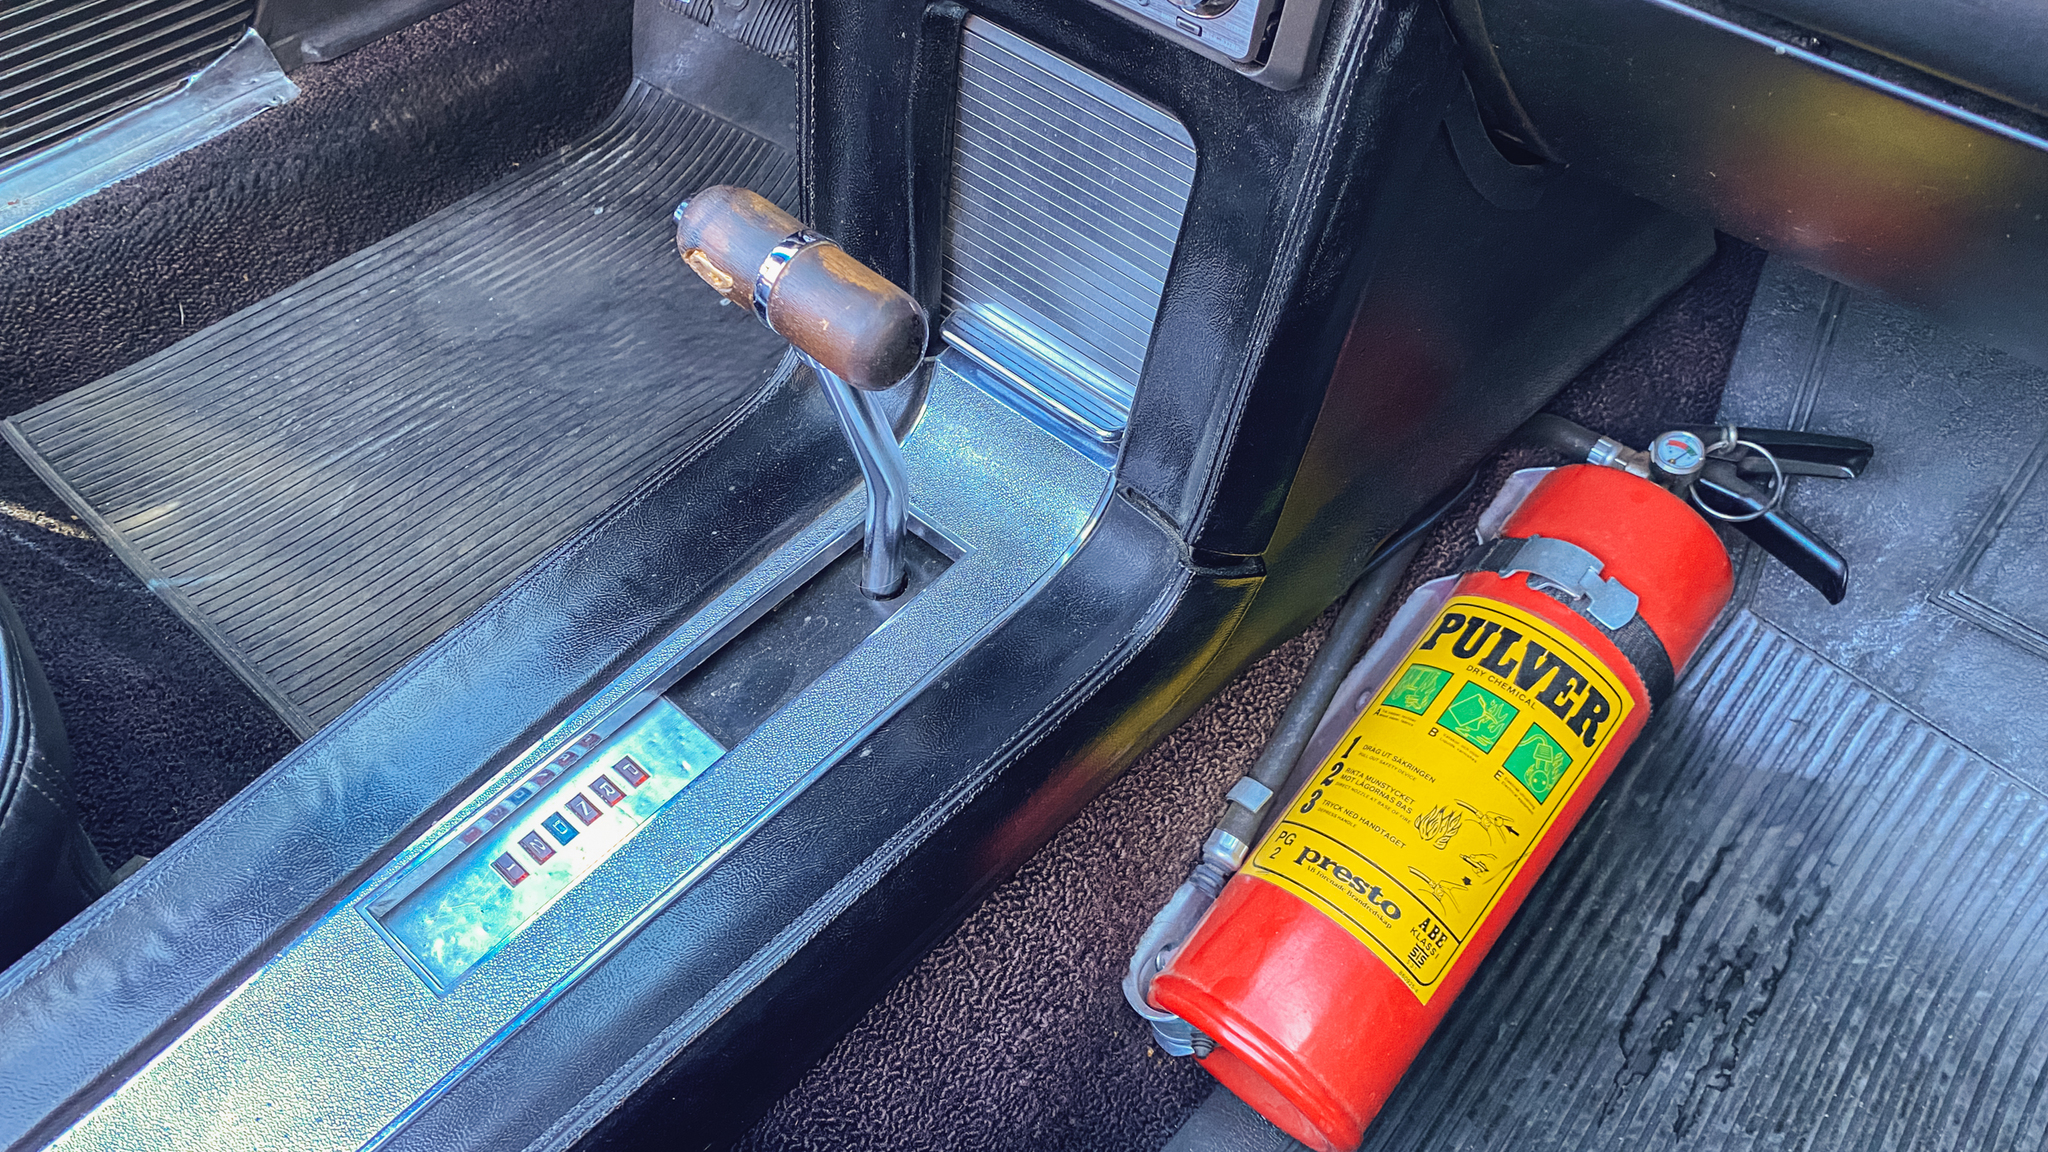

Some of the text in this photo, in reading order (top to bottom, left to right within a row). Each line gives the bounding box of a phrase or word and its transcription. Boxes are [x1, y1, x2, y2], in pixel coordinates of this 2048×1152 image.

[1419, 613, 1610, 747] PULVER
[1466, 665, 1535, 710] DRY CHEMICAL
[1428, 727, 1439, 737] B
[1341, 736, 1362, 759] 1
[1362, 744, 1381, 754] DRAG
[622, 763, 638, 776] P
[1320, 762, 1344, 786] 2
[1379, 760, 1398, 770] SAFETY
[1397, 769, 1416, 781] DEVICE
[1493, 769, 1504, 781] E
[599, 782, 615, 796] R
[1340, 774, 1413, 814] MOT LÅGORNAS BAS
[1345, 767, 1415, 805] RIKTA MUNSTYCKET
[575, 800, 590, 816] N
[1300, 789, 1323, 814] 3
[1335, 781, 1351, 789] DIRECT
[1351, 787, 1370, 798] NOZZLE
[1377, 801, 1391, 810] BASE
[1399, 814, 1411, 824] FIRE
[1317, 807, 1356, 828] DEPRESS HANDLE
[1322, 799, 1406, 849] TRYCK NED HANDTAGET
[528, 837, 545, 854] 2
[1276, 831, 1296, 846] PG
[1269, 847, 1281, 859] 2
[1293, 846, 1401, 920] presto
[1346, 890, 1392, 929] Brandredskap
[1418, 918, 1448, 949] ABE
[1410, 947, 1427, 966] SIS
